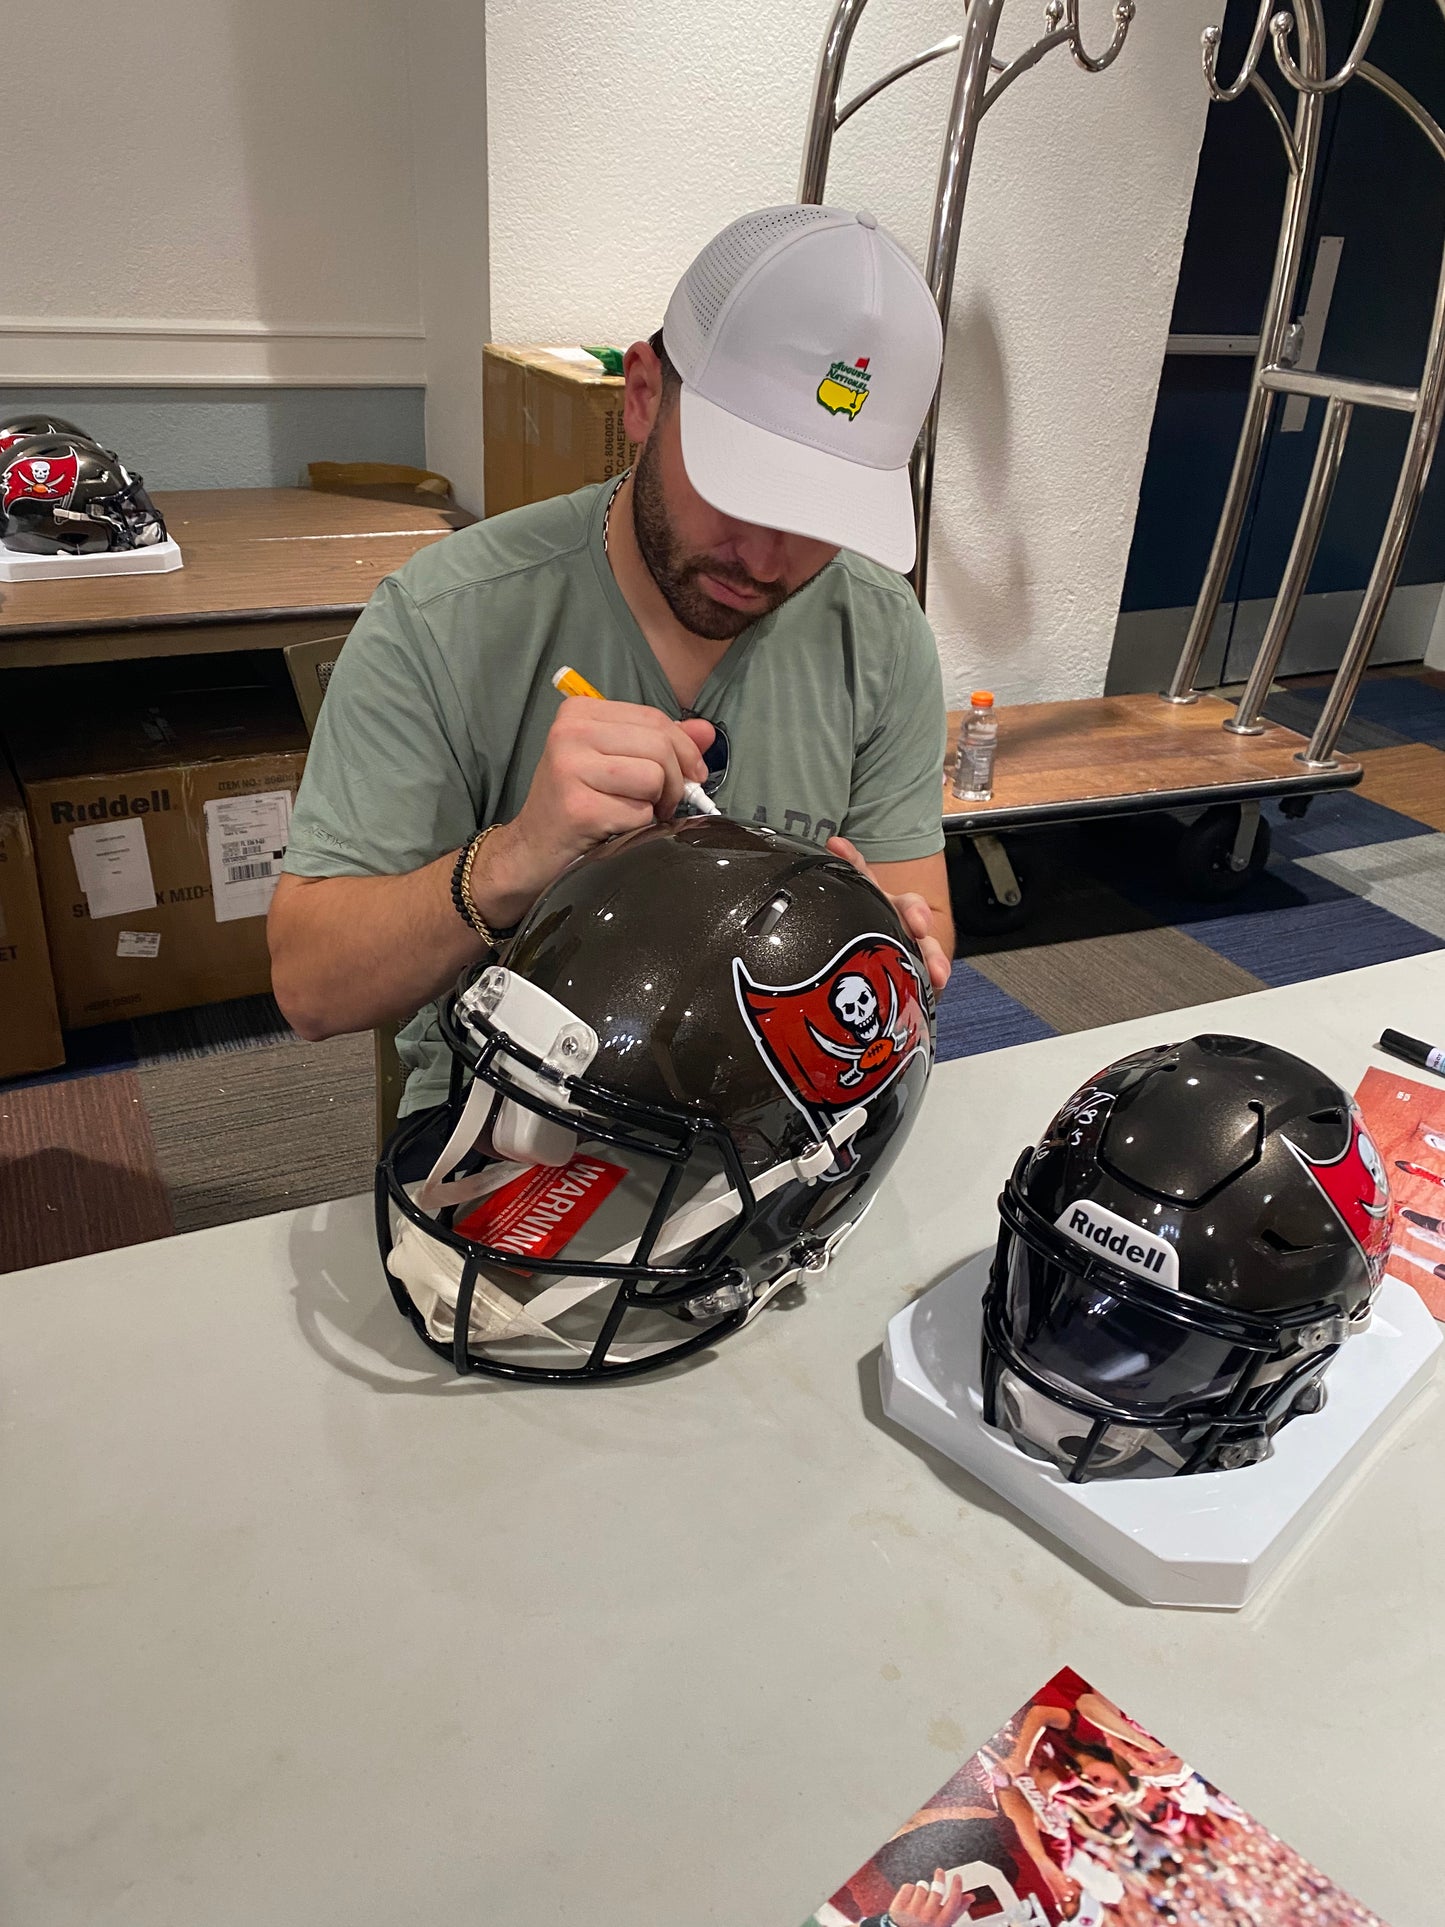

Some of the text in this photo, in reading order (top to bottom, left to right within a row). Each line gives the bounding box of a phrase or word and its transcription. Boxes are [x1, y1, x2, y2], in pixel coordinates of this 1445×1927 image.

[604, 410, 614, 456] 8060034
[616, 409, 626, 475] CCANEERS
[51, 789, 171, 825] Riddell
[1068, 1208, 1167, 1274] Riddell
